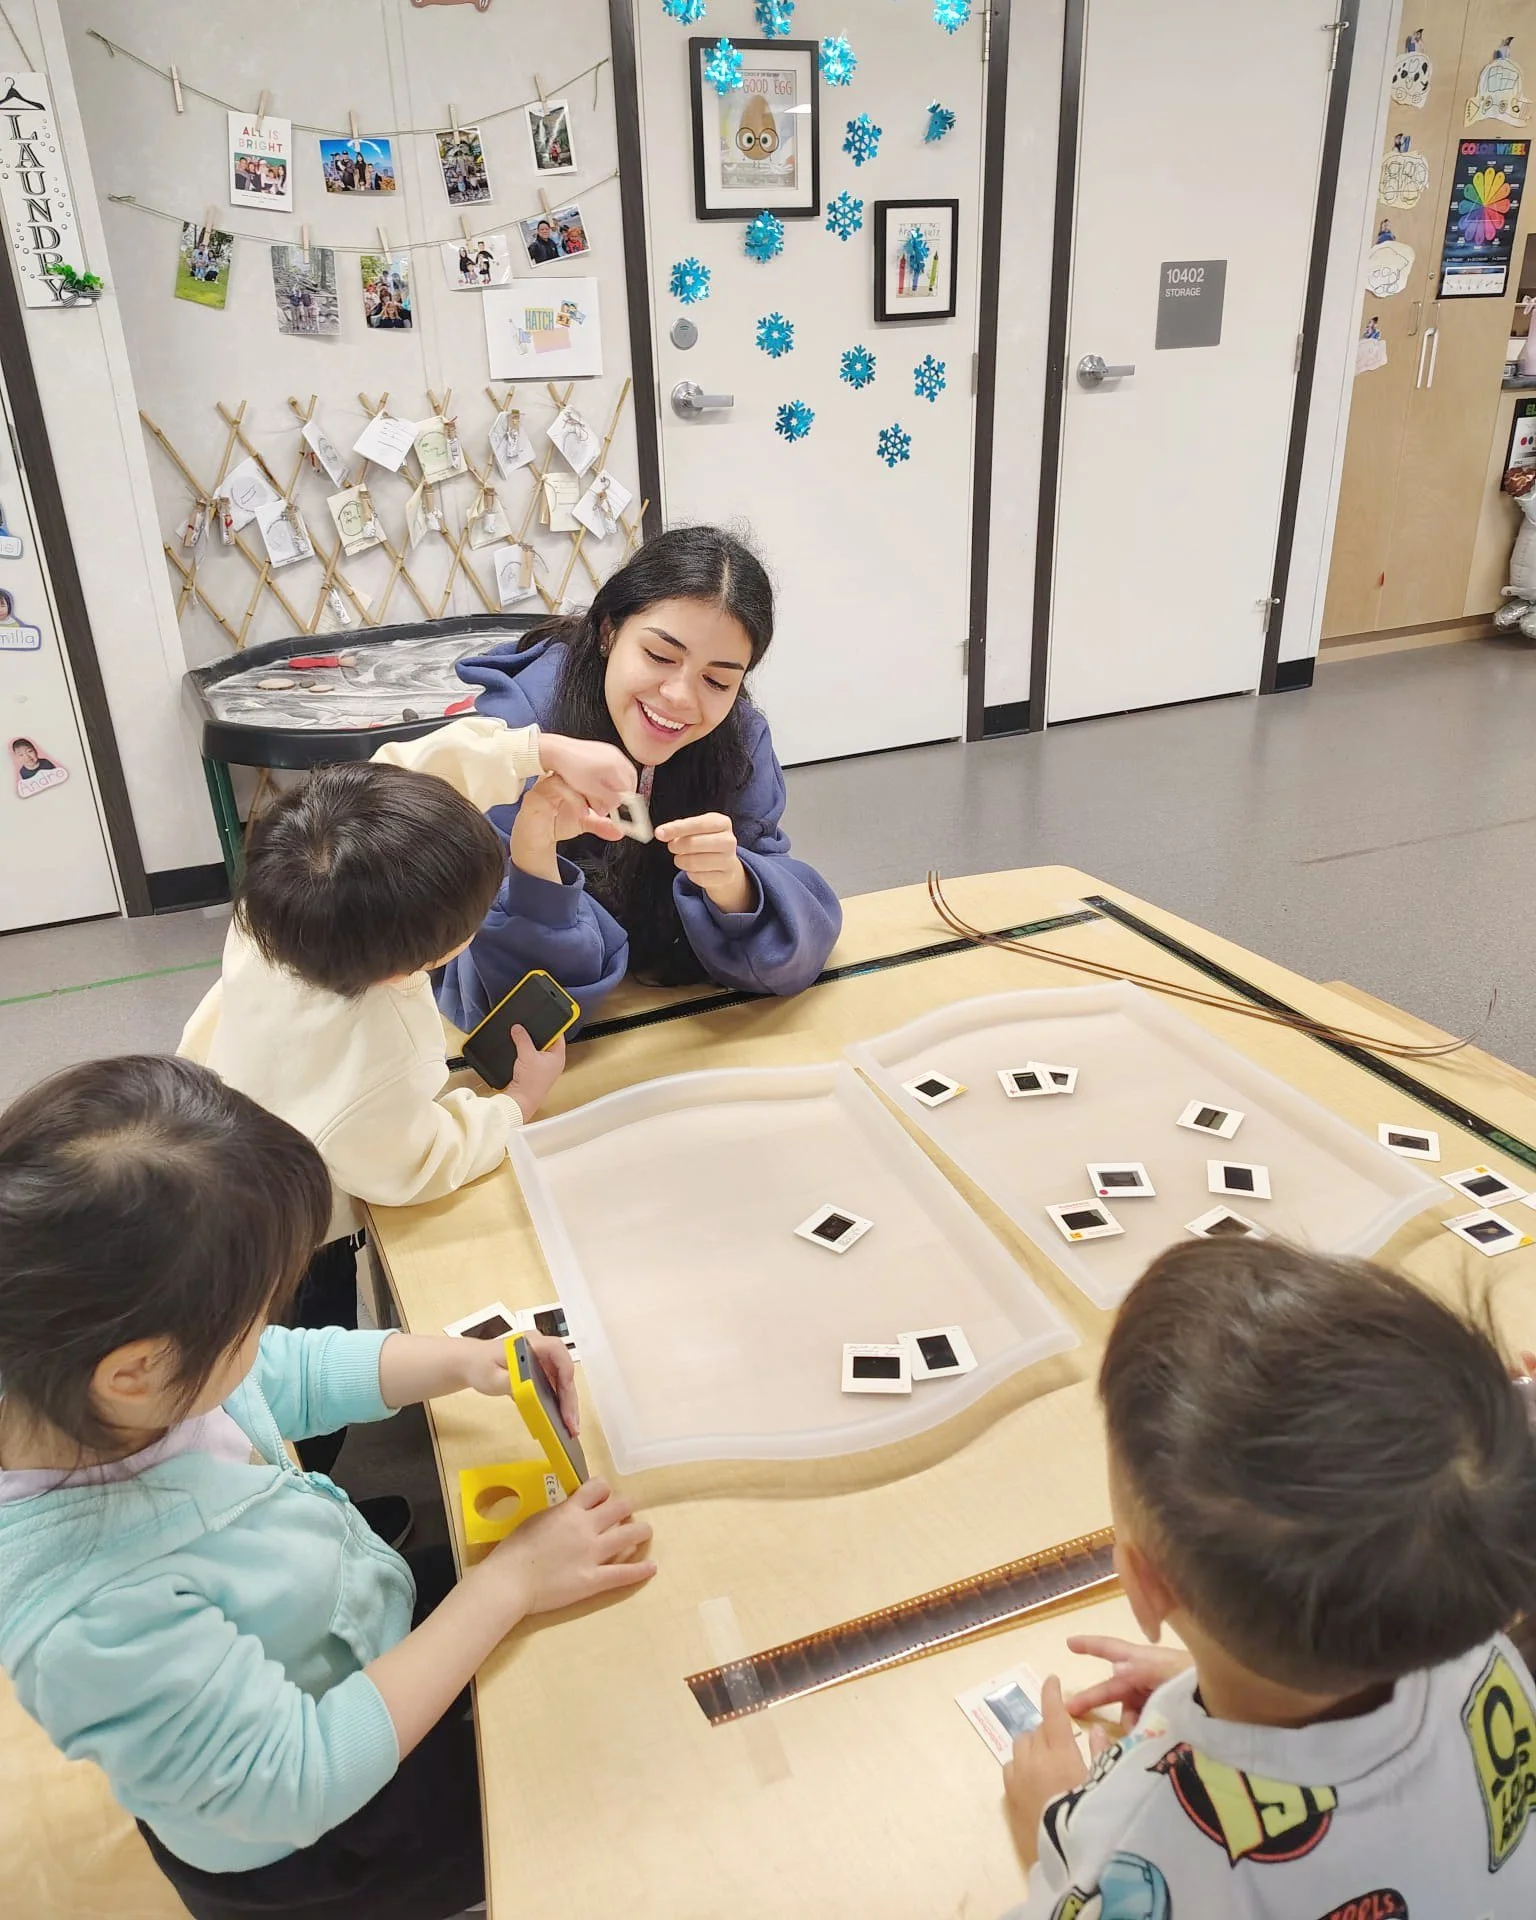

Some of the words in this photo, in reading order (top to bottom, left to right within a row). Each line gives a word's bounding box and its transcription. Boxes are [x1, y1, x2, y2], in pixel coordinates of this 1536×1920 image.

[743, 78, 769, 94] GOOD
[774, 79, 792, 96] EGG
[242, 126, 264, 138] ALL
[268, 129, 280, 140] IS
[238, 138, 283, 153] BRIGHT
[1166, 267, 1205, 284] 10402
[1165, 287, 1201, 298] STORAGE
[524, 308, 554, 331] HATCH
